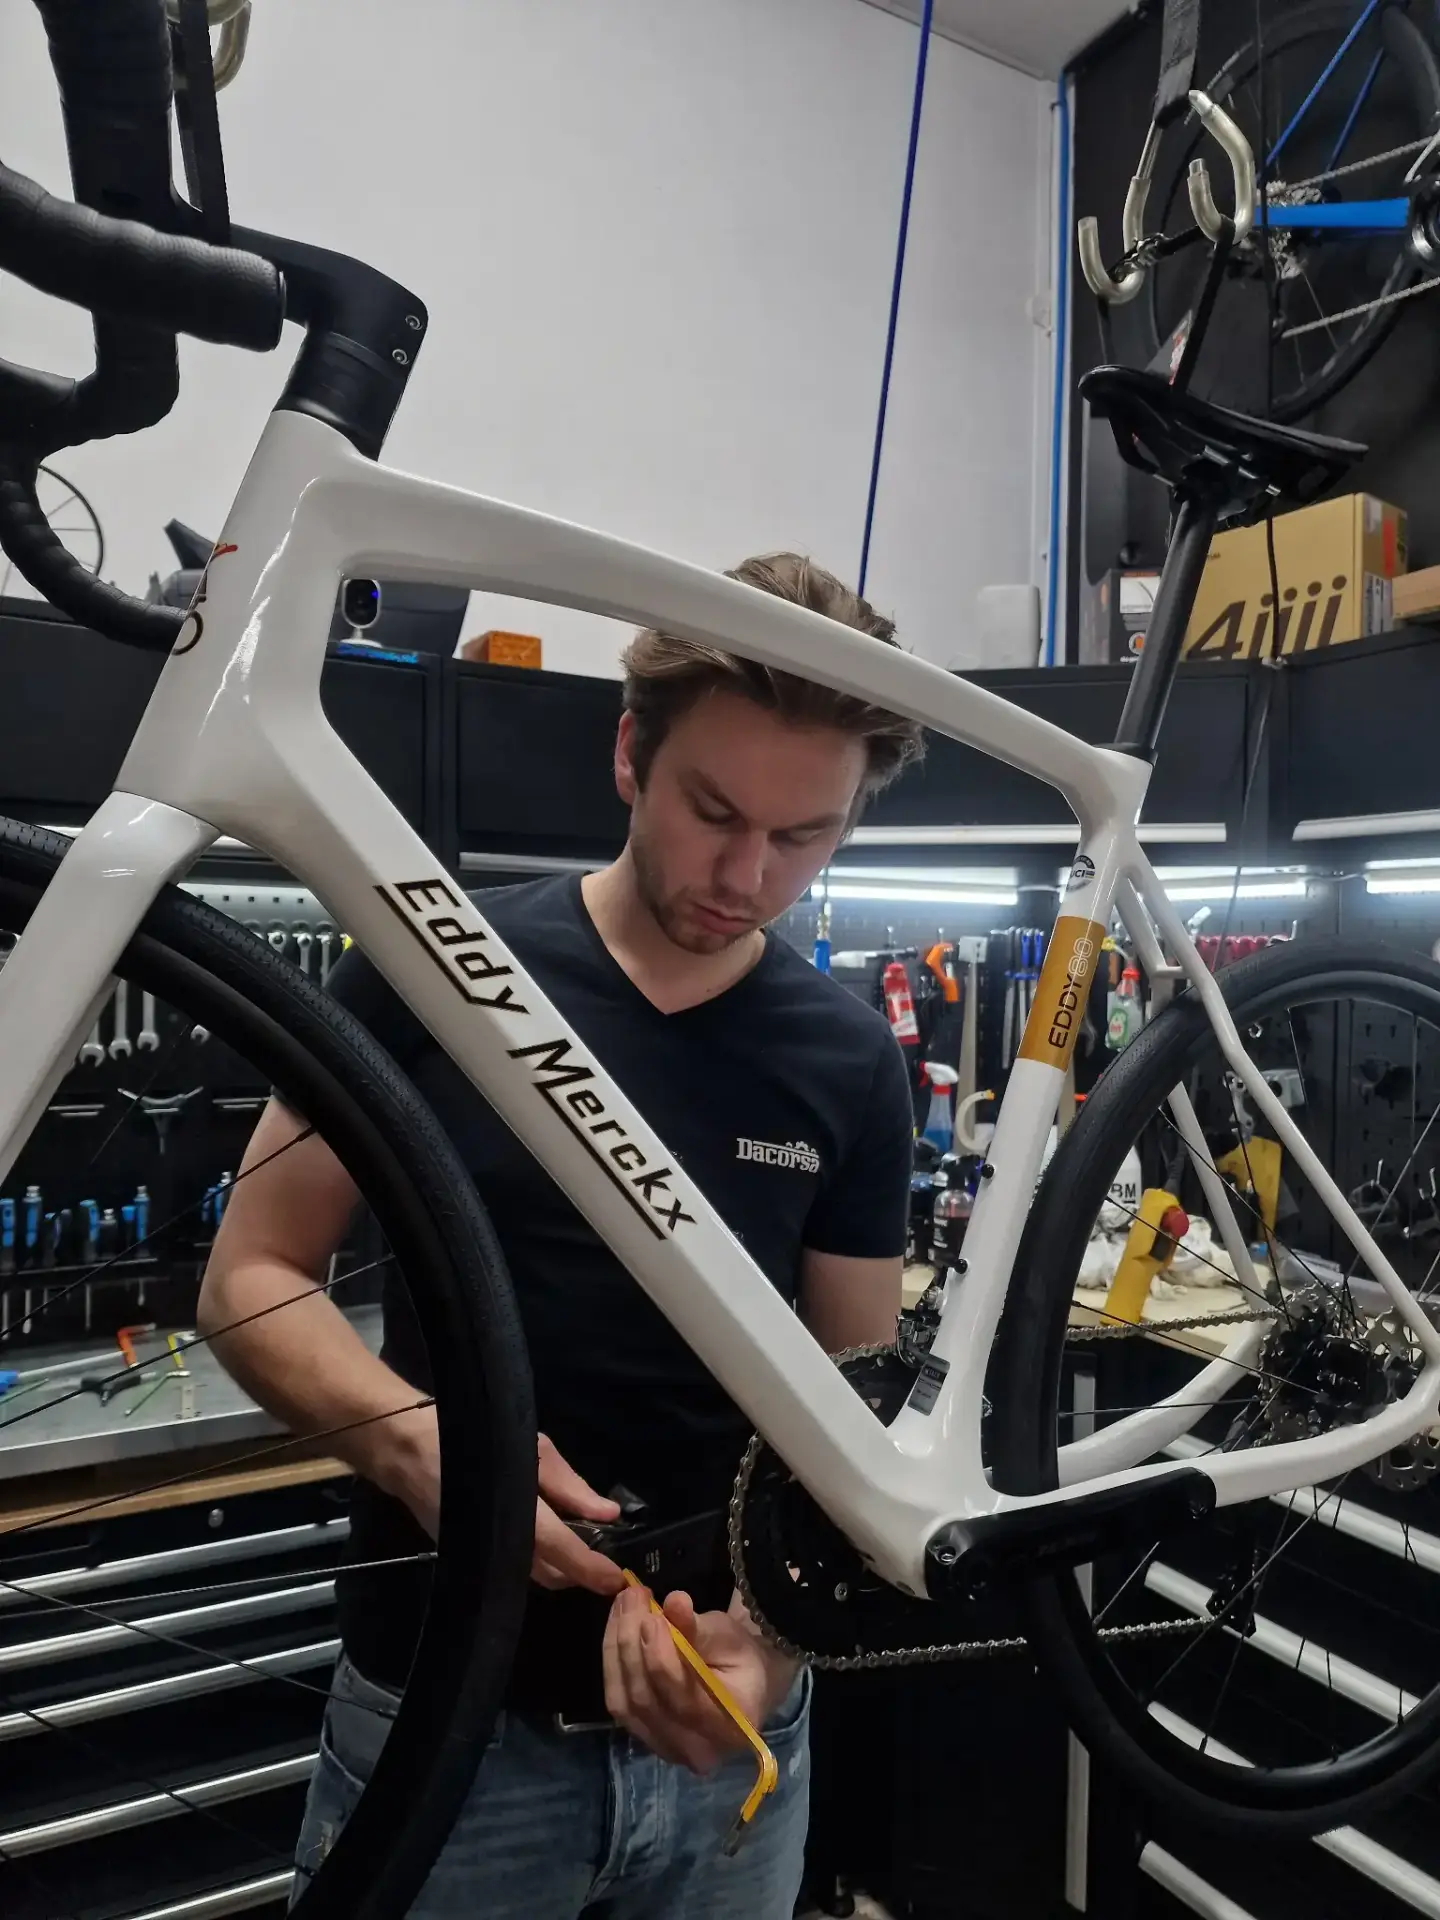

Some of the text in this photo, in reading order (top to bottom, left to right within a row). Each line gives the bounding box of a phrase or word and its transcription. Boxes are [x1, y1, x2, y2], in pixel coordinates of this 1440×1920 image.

[374, 878, 698, 1240] Eddy Merckx
[735, 1137, 820, 1174] Dacorsa
